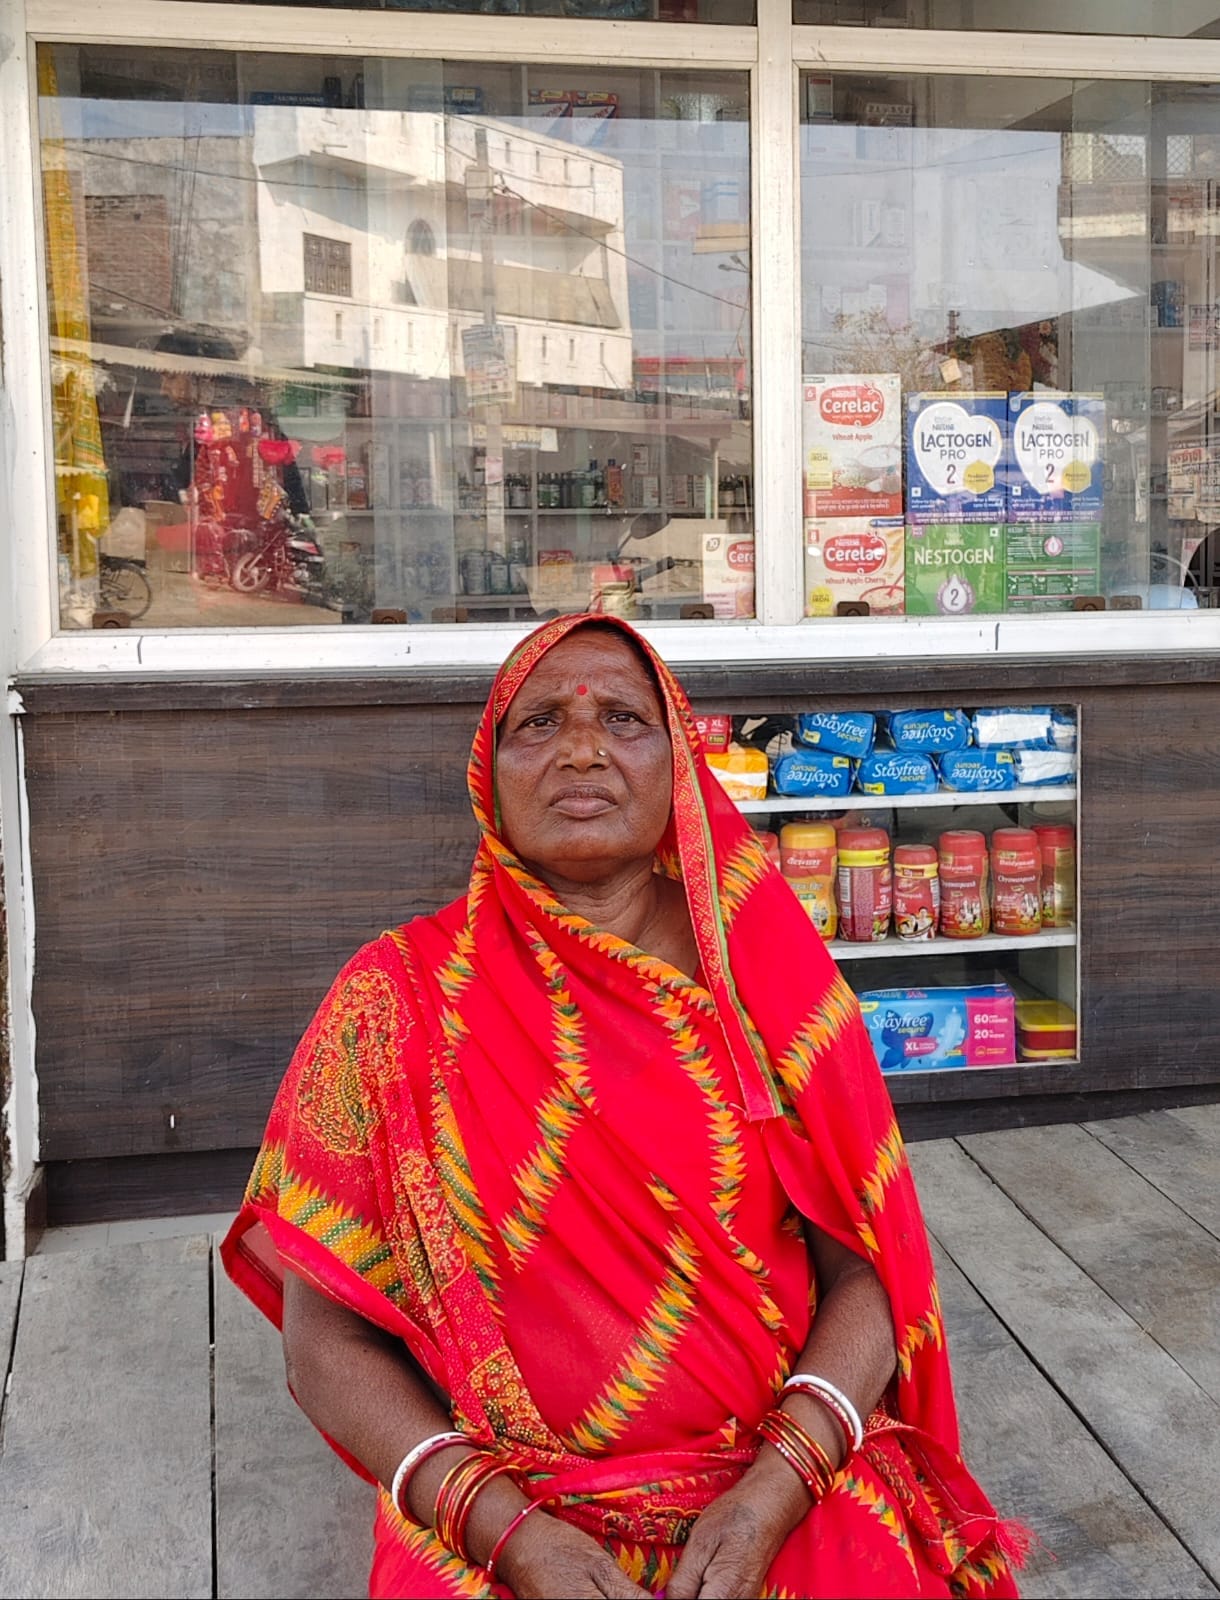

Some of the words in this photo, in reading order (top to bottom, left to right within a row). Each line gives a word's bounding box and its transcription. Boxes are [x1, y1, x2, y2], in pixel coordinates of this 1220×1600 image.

[822, 398, 880, 413] Cerelac
[921, 431, 992, 452] LACTOGEN
[1021, 430, 1090, 452] LACTOGEN
[940, 449, 967, 460] PRO
[1039, 448, 1065, 460] PRO
[946, 463, 957, 485] 2
[1045, 463, 1055, 484] 2
[825, 547, 884, 561] Cerelac
[914, 545, 995, 565] NESTOGEN
[950, 588, 959, 607] 2
[711, 719, 724, 727] XL
[811, 712, 868, 738] Stayfree
[903, 722, 930, 731] secure
[837, 731, 864, 744] secure
[901, 724, 956, 745] Stayfree
[786, 769, 843, 788] Stayfree
[872, 761, 928, 780] Stayfree
[900, 774, 926, 782] secure
[951, 765, 1007, 785] Stayfree
[870, 1012, 929, 1032] Stayfree
[974, 1014, 989, 1024] 60
[974, 1029, 989, 1040] 20
[905, 1042, 920, 1051] XL
